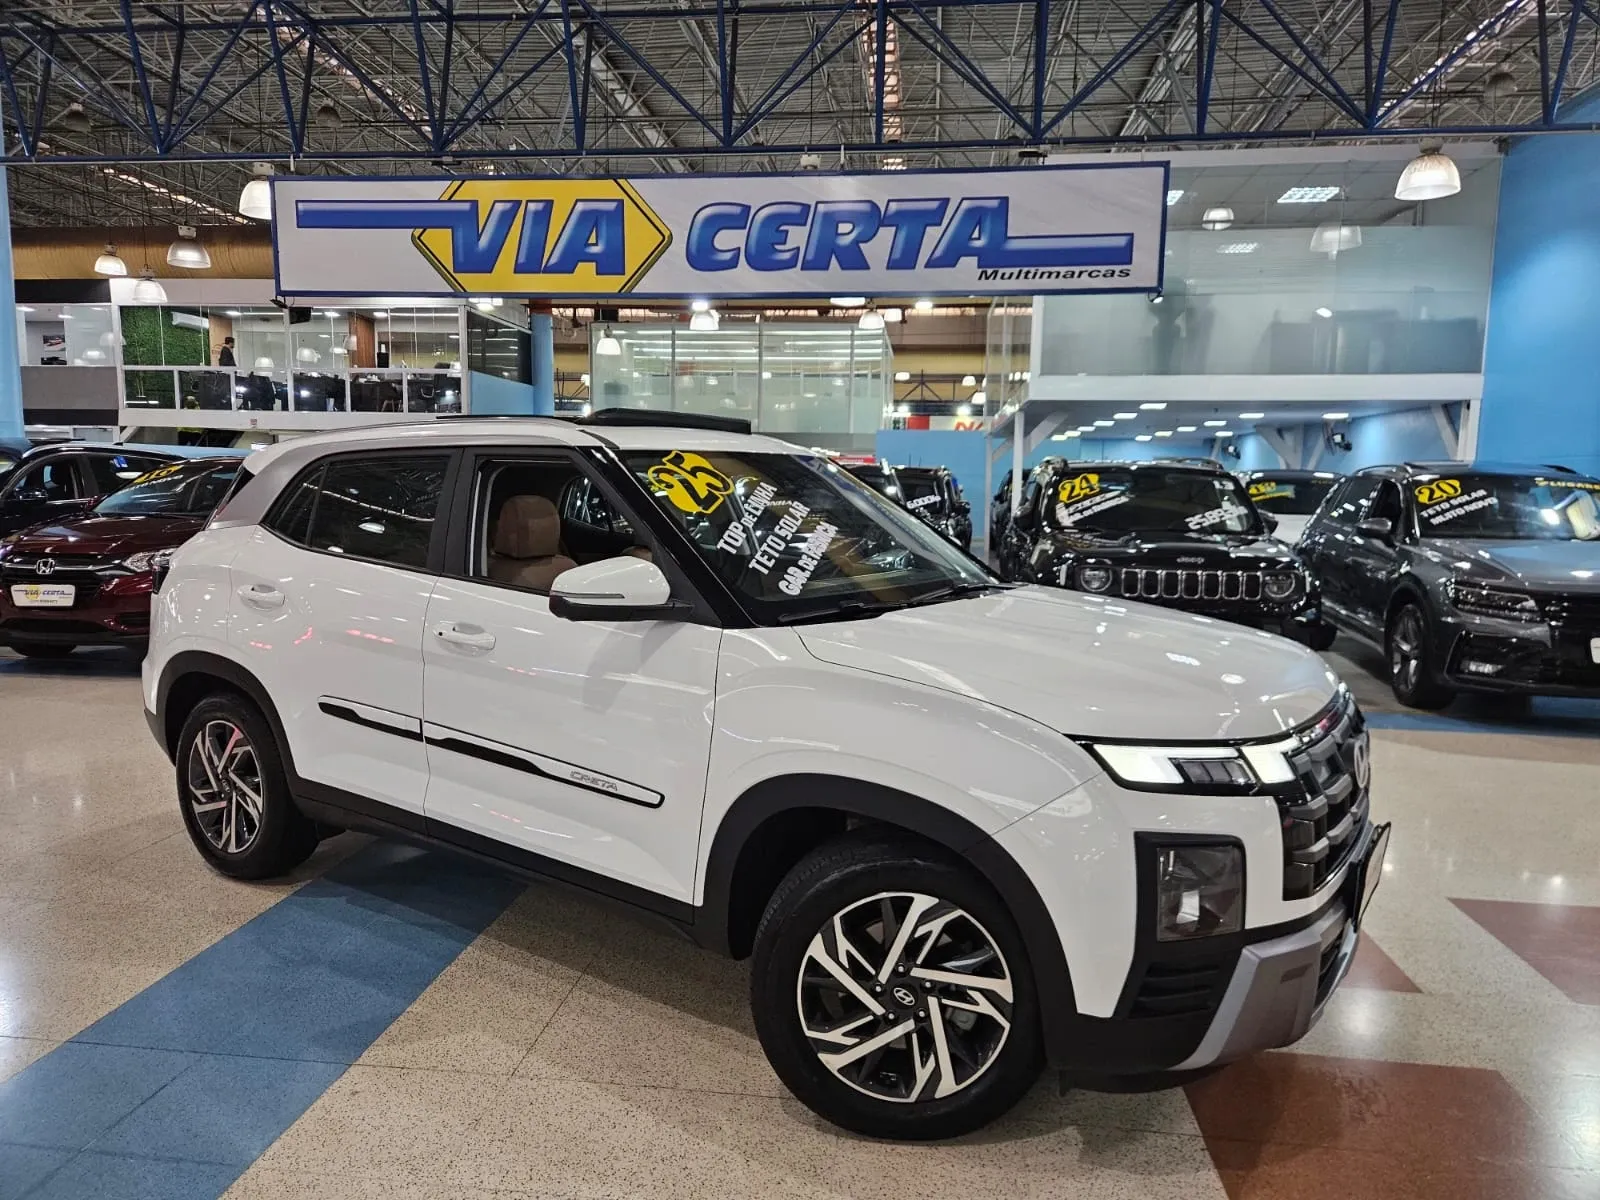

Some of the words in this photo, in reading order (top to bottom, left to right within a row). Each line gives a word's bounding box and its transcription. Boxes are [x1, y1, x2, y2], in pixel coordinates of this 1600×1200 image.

[451, 198, 627, 276] VIA
[685, 196, 1012, 271] CERTA
[977, 266, 1131, 281] Multimarcas
[648, 450, 735, 514] 25
[1059, 474, 1100, 503] 24
[1415, 479, 1461, 504] 20
[744, 481, 778, 522] LINHA
[1420, 502, 1450, 518] TETO
[1449, 489, 1488, 507] SOLAR
[1430, 505, 1466, 526] MUITO
[1465, 496, 1499, 513] NOVO
[740, 509, 754, 528] DE
[716, 521, 747, 554] TOP
[749, 534, 787, 575] TETO
[774, 500, 811, 541] SOLAR
[798, 552, 816, 572] DE
[569, 770, 618, 791] CRETA
